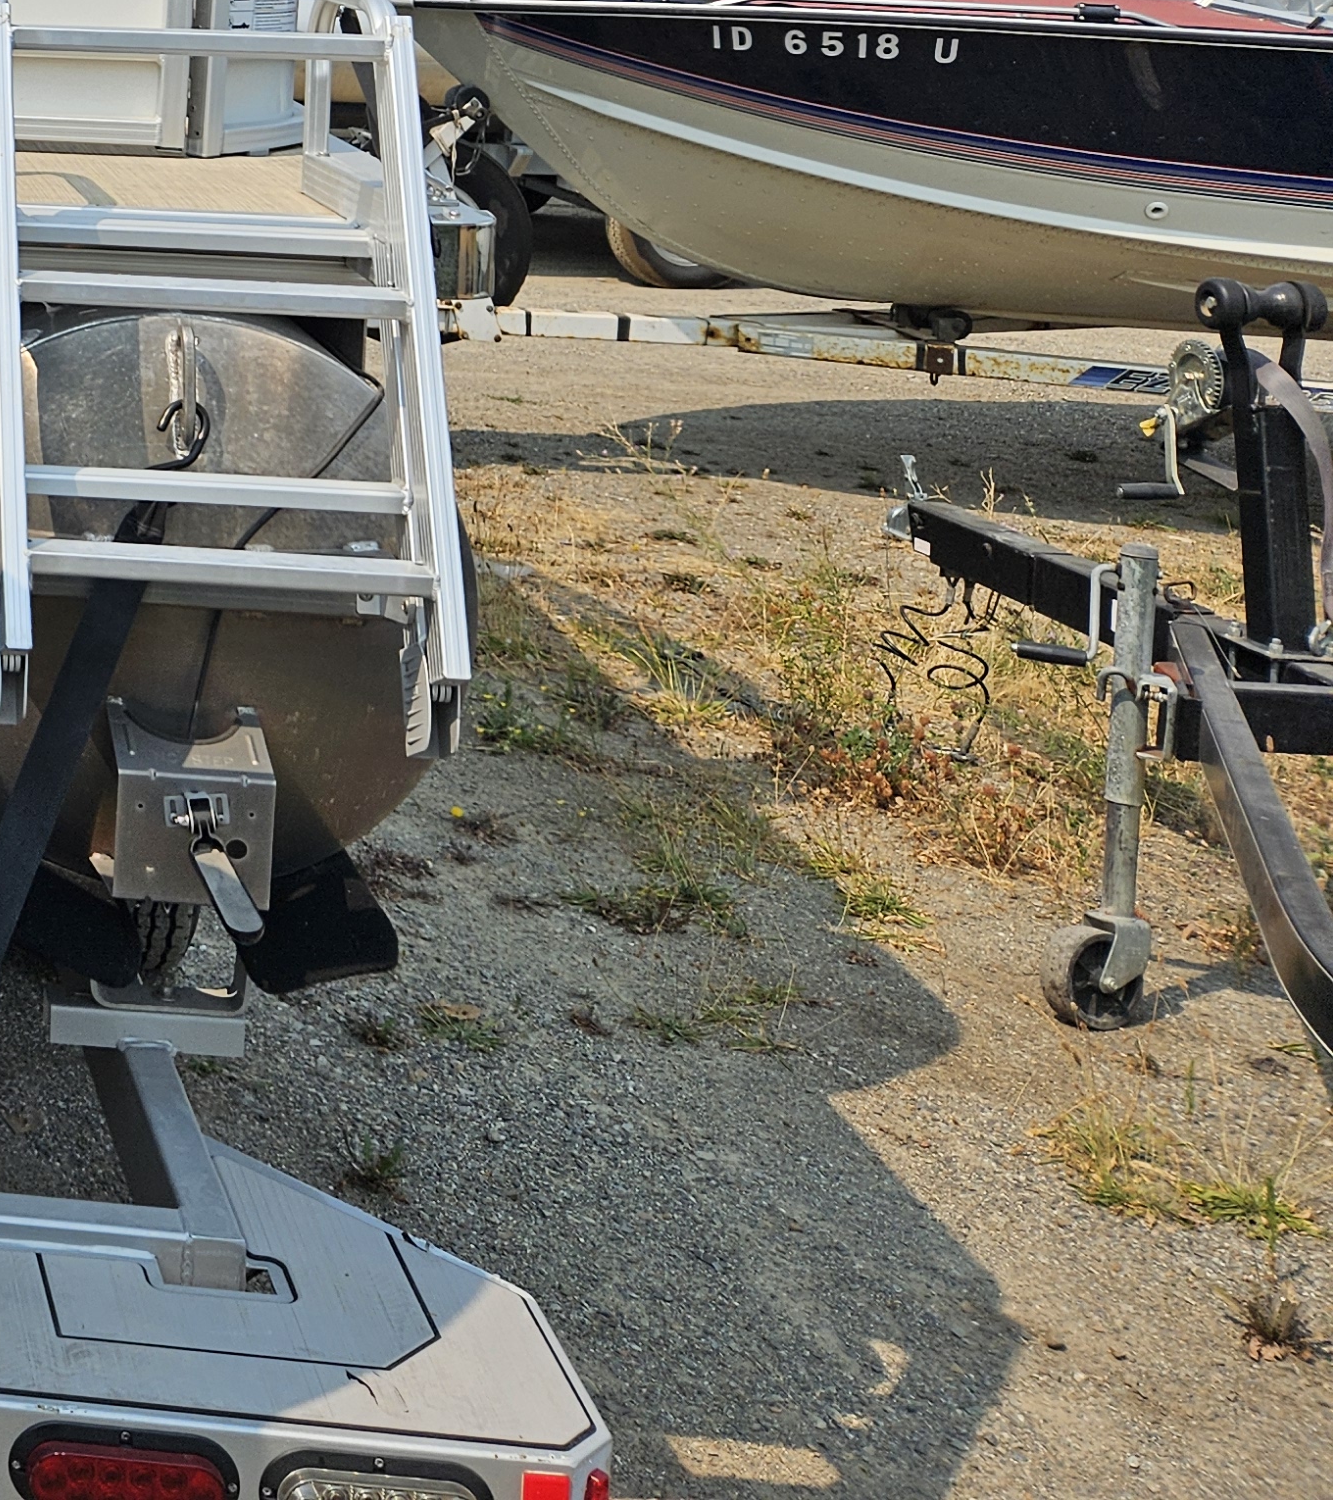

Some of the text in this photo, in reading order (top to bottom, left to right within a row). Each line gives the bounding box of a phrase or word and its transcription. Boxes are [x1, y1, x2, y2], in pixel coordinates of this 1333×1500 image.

[712, 25, 960, 64] ID 6518 U
